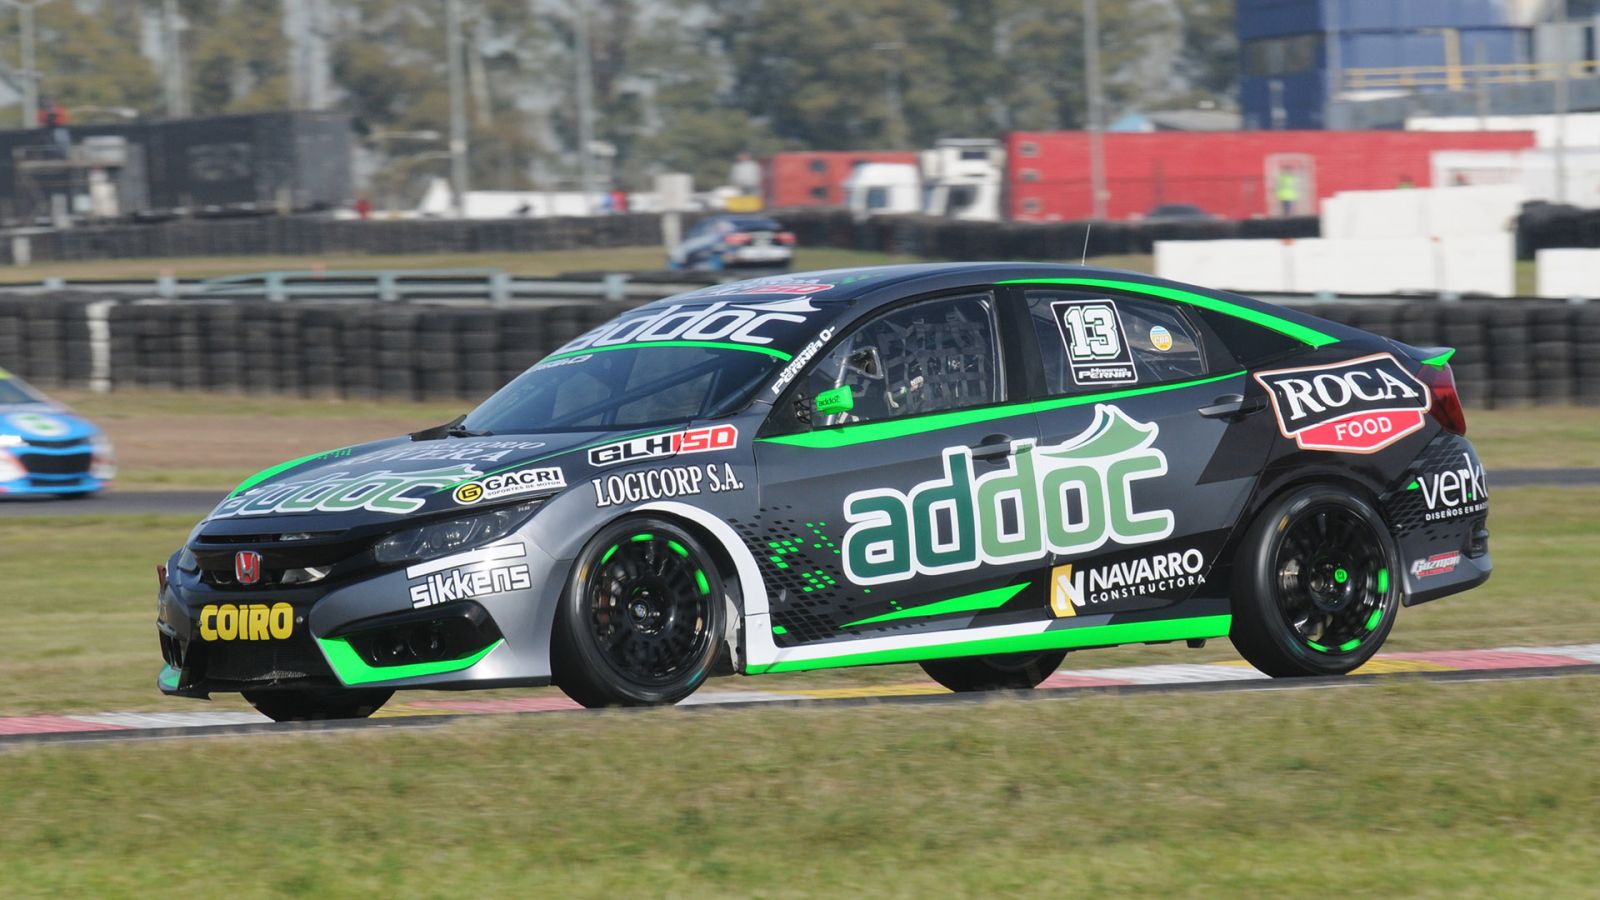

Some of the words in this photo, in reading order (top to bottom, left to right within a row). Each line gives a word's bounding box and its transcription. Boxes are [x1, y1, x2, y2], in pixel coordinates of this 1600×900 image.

[1064, 305, 1121, 361] 13
[1274, 368, 1419, 420] ROCA
[1335, 416, 1392, 441] FOOD
[485, 470, 560, 491] GACRI
[592, 466, 703, 507] LOGICORP
[706, 463, 744, 492] S.A.
[842, 437, 1175, 586] addoc
[409, 564, 532, 609] sikkens
[1089, 548, 1204, 592] NAVARRO
[1090, 574, 1206, 604] CONSTRUCTORA
[200, 602, 294, 641] COIRO
